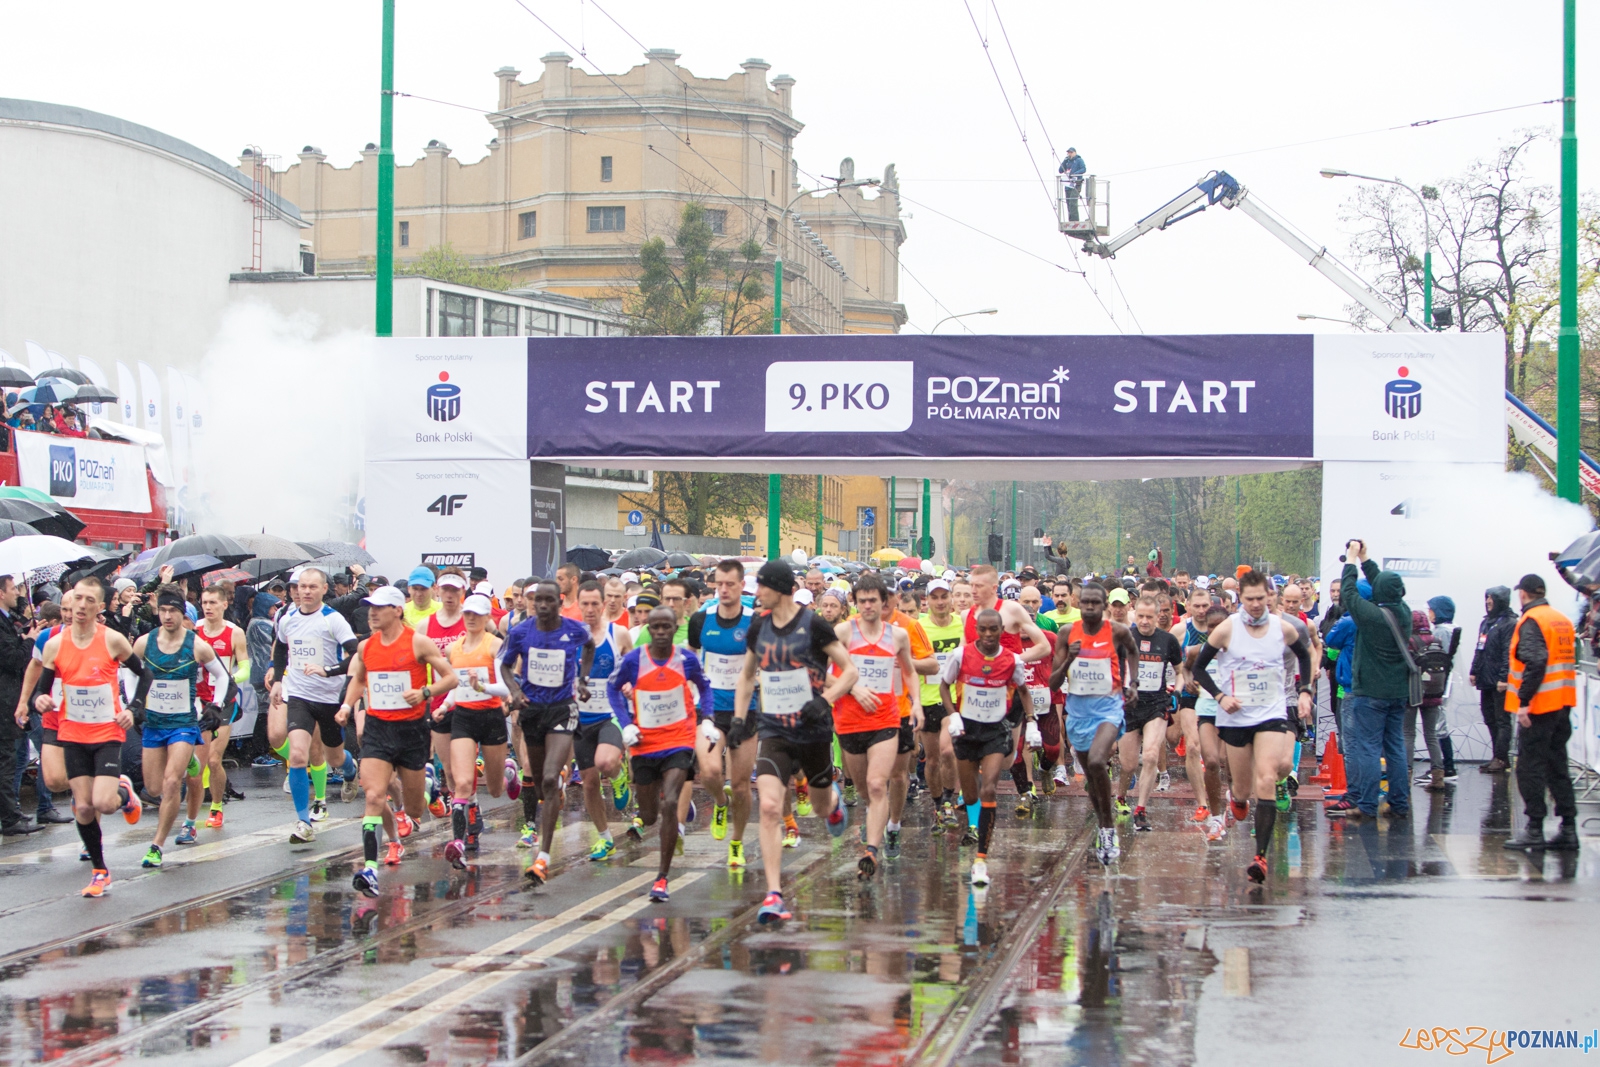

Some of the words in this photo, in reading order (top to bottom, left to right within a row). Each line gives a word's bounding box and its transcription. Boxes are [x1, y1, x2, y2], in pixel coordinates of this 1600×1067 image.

[415, 353, 443, 361] Sponsor
[445, 353, 473, 361] tytularny
[1372, 351, 1401, 359] Sponsor
[585, 381, 721, 413] START
[820, 383, 890, 410] PKO
[1113, 380, 1256, 413] START
[927, 403, 1060, 420] PÓŁMARATON
[415, 432, 441, 443] Bank
[444, 432, 473, 442] Polski
[1372, 430, 1399, 441] Bank
[1403, 430, 1435, 441] Polski
[53, 460, 73, 482] PKO
[416, 472, 443, 480] Sponsor
[444, 471, 479, 480] techniczny
[427, 494, 468, 516] 4F
[435, 535, 462, 543] Sponsor
[423, 554, 472, 566] 4MOVE
[1385, 560, 1438, 571] 4MOVE
[292, 647, 316, 657] 3450
[530, 660, 563, 672] Biwot
[710, 664, 743, 675] Tarasiu
[1072, 669, 1105, 680] Metto
[373, 682, 404, 693] Ochal
[1248, 682, 1268, 691] 941
[150, 687, 183, 701] Ślęzak
[591, 690, 608, 699] 33
[70, 696, 106, 709] Łucyk
[642, 700, 678, 713] Kyeva
[967, 696, 1000, 709] Muteti
